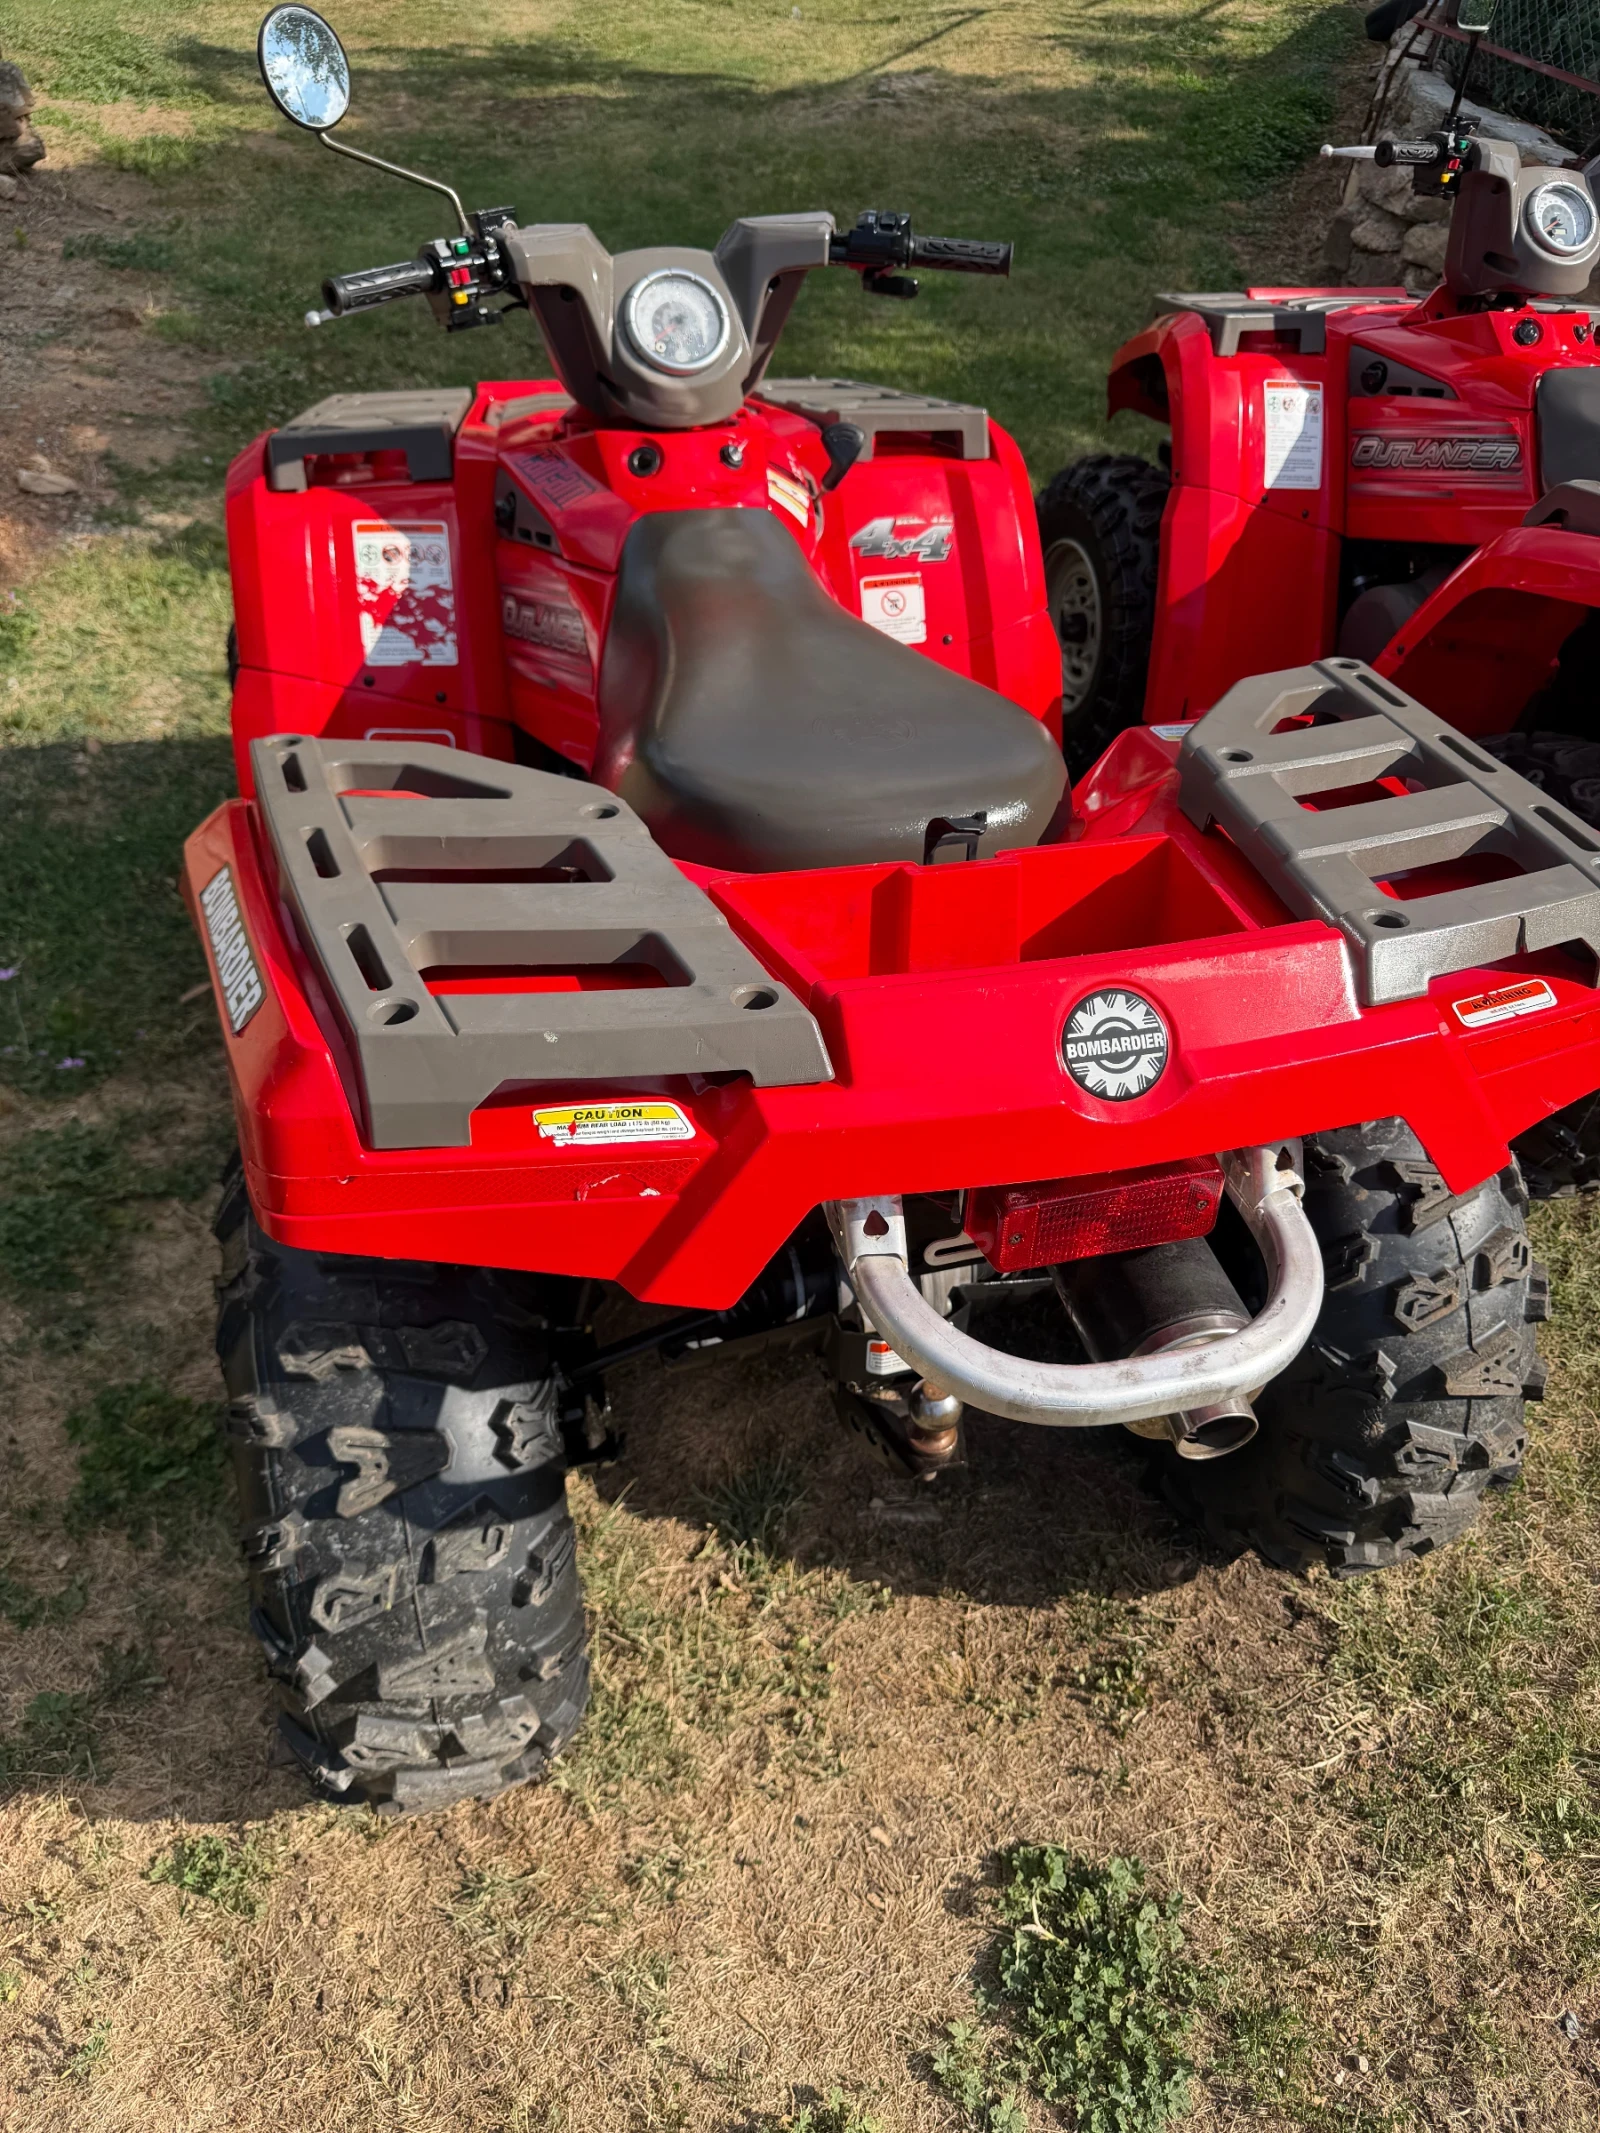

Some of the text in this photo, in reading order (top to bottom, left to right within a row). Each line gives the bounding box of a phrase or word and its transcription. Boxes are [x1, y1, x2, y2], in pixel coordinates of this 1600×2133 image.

[1352, 437, 1520, 469] OUTLANDER
[848, 517, 952, 562] 4x4
[201, 867, 262, 1031] BOMBARDIER
[1481, 987, 1532, 1007] WARNING
[1066, 1032, 1164, 1059] BOMBARDIER
